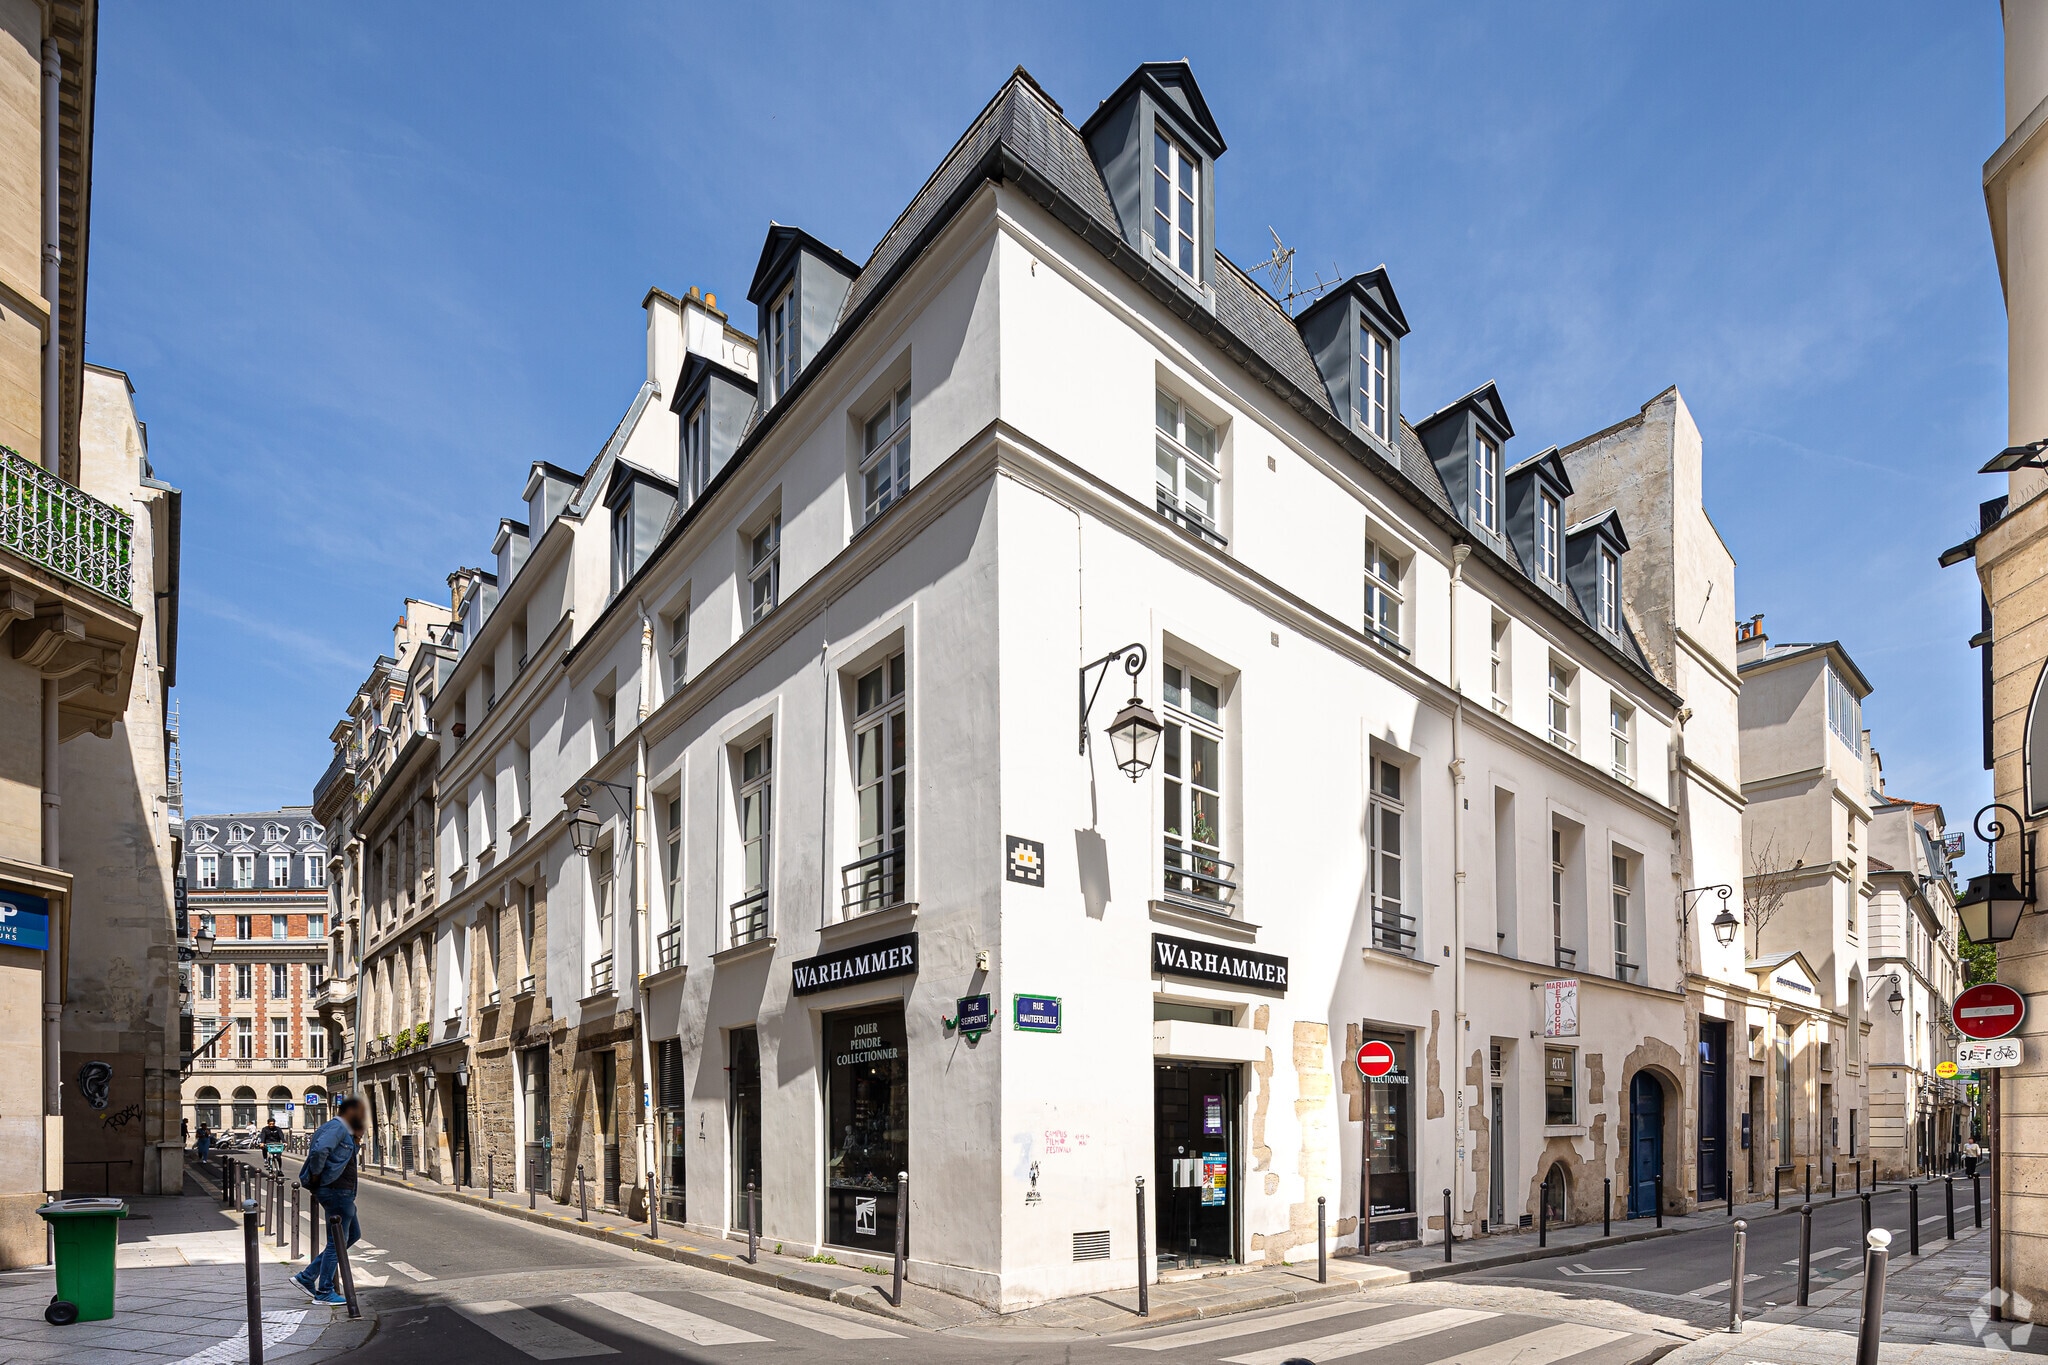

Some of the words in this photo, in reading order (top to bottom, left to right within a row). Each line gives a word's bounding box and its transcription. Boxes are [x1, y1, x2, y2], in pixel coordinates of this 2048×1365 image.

[0, 925, 17, 934] IVÉ
[793, 944, 914, 989] WARHAMMER
[1156, 941, 1287, 985] WARHAMMER
[1546, 980, 1577, 990] MARIANA
[967, 1002, 980, 1012] RUE
[1032, 1001, 1045, 1011] RUE
[1554, 982, 1562, 1036] RETOUCHE
[960, 1013, 988, 1026] SERPENTE
[1019, 1013, 1057, 1025] HAUTEFEUILLE
[854, 1022, 878, 1038] JOUER
[850, 1036, 882, 1051] PEINDRE
[836, 1047, 899, 1066] COLLECTIONNER
[1959, 1048, 1992, 1061] SAF
[1362, 1074, 1410, 1085] CLLECTIONNER
[1044, 1130, 1068, 1138] CAMPUS
[1046, 1137, 1060, 1145] FILM
